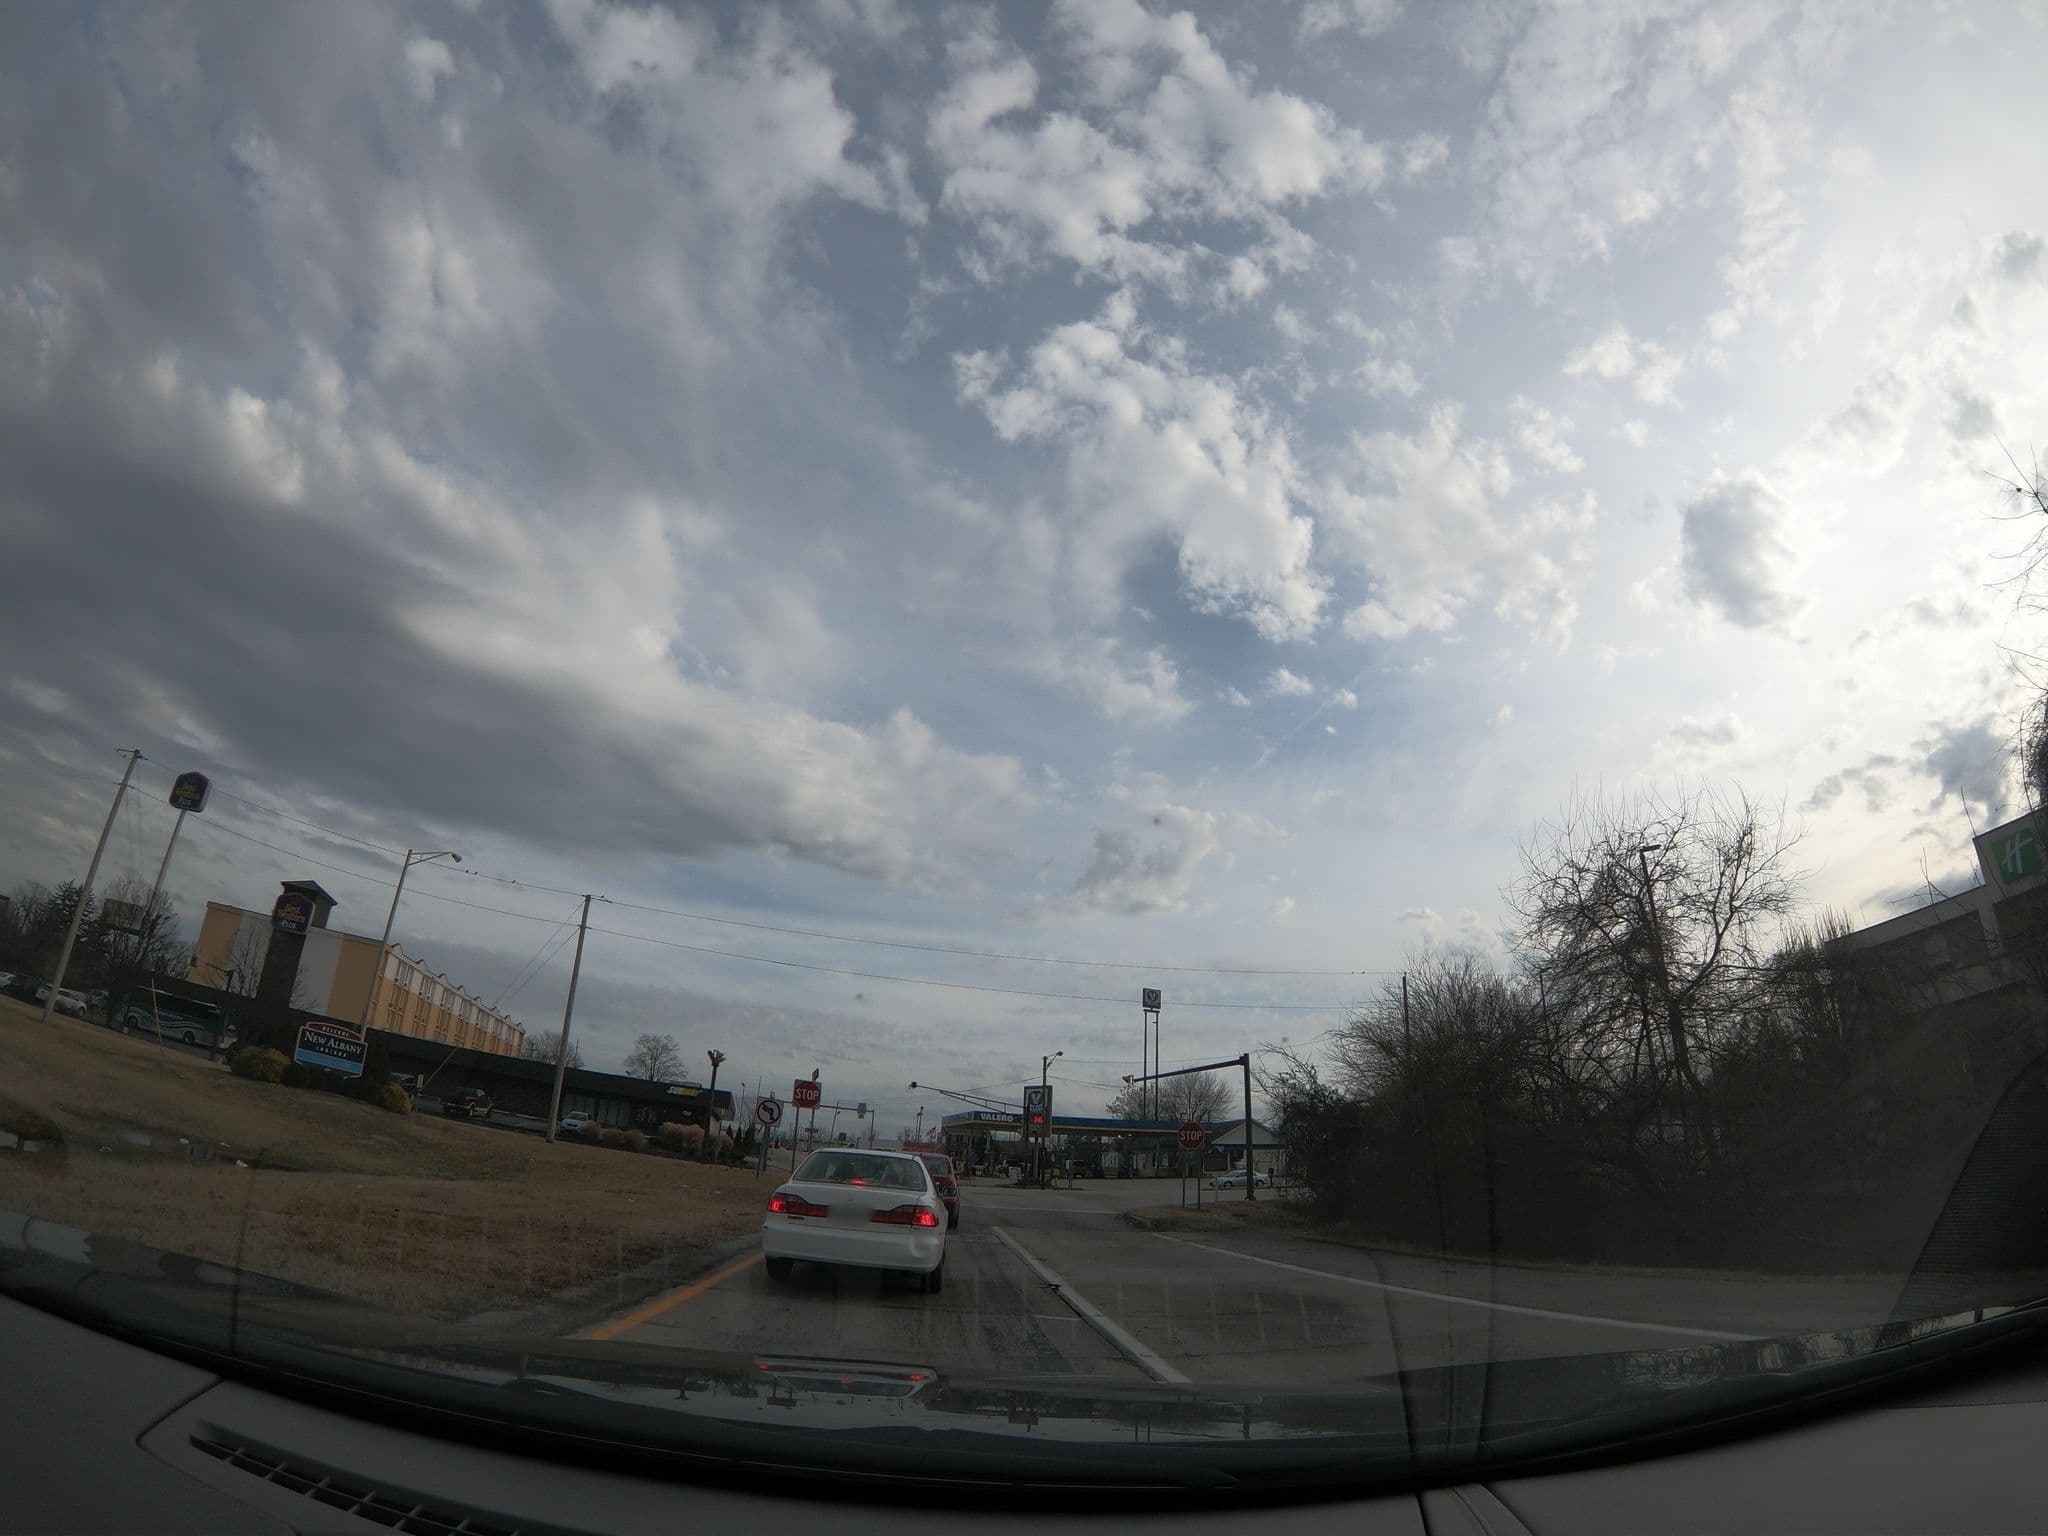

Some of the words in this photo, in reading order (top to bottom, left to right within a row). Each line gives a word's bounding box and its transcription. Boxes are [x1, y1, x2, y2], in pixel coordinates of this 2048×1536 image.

[667, 1086, 703, 1097] SUBWAY
[795, 1088, 820, 1101] STOP
[980, 1112, 1014, 1123] VALERO
[1179, 1130, 1203, 1141] STOP
